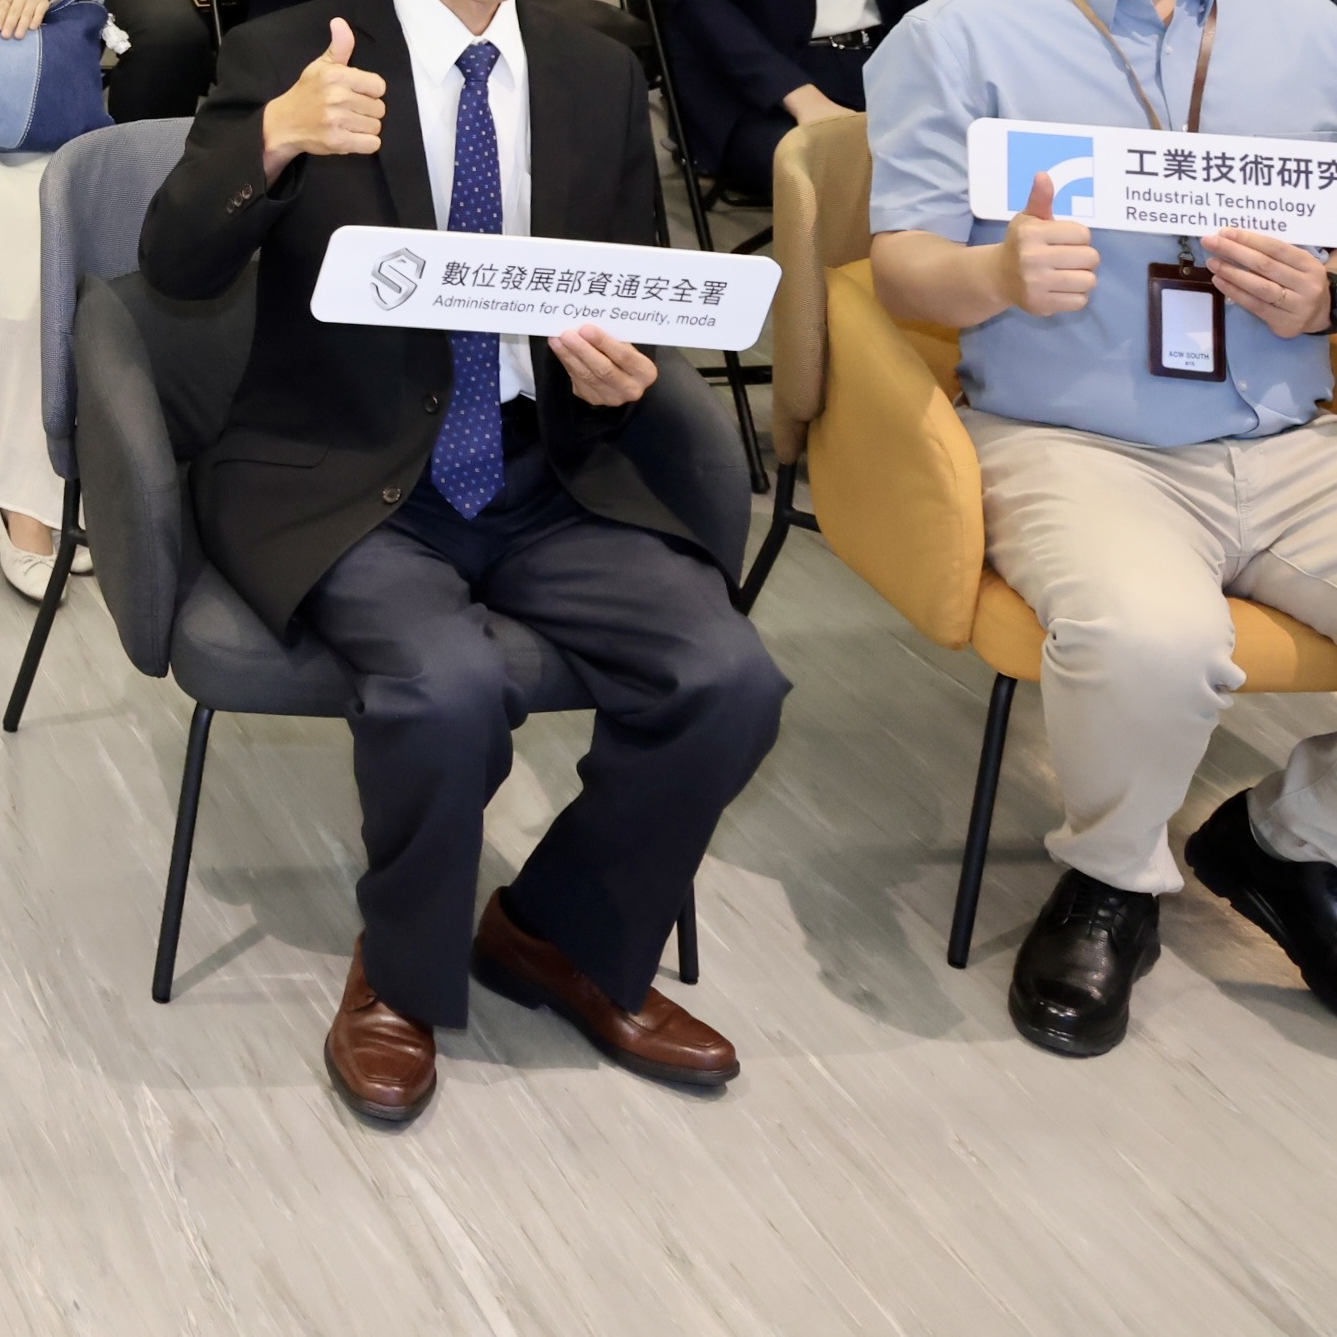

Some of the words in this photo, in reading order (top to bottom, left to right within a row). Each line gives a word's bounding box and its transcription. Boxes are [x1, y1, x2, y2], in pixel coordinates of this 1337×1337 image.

[1125, 186, 1211, 207] Industrial
[1214, 191, 1316, 217] Technology
[1126, 206, 1208, 226] Research
[1213, 212, 1288, 232] Institute
[441, 260, 729, 307] 數位發展部資通安全署
[433, 294, 535, 315] Administration
[539, 302, 560, 316] for
[563, 303, 606, 322] Cyber
[609, 307, 671, 327] Security,
[676, 313, 717, 328] moda
